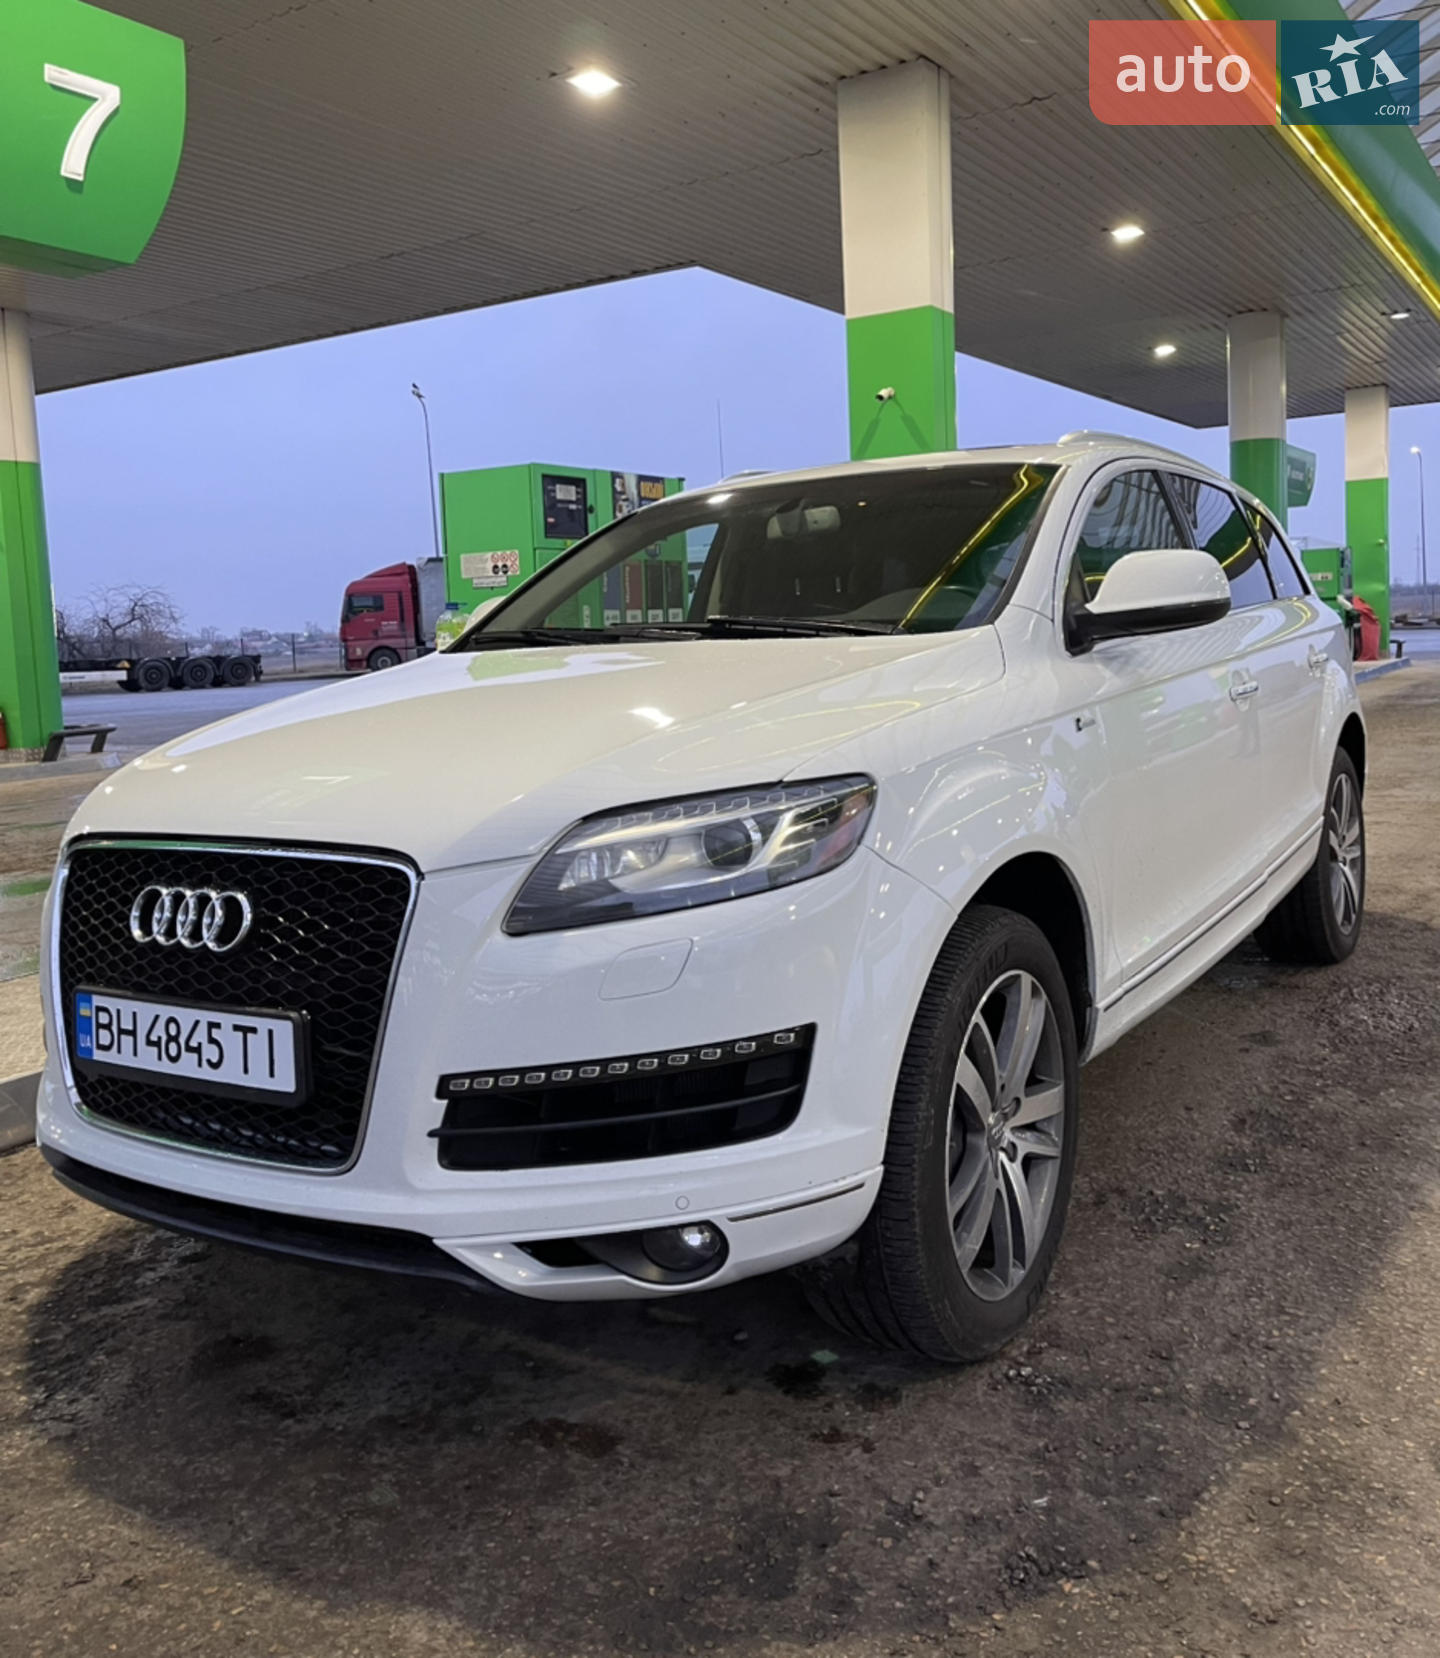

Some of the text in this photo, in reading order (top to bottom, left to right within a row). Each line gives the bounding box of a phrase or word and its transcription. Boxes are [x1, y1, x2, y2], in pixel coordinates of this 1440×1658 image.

[44, 62, 121, 182] 7
[79, 1033, 92, 1048] UA
[94, 1005, 276, 1079] BH 4845 TI
